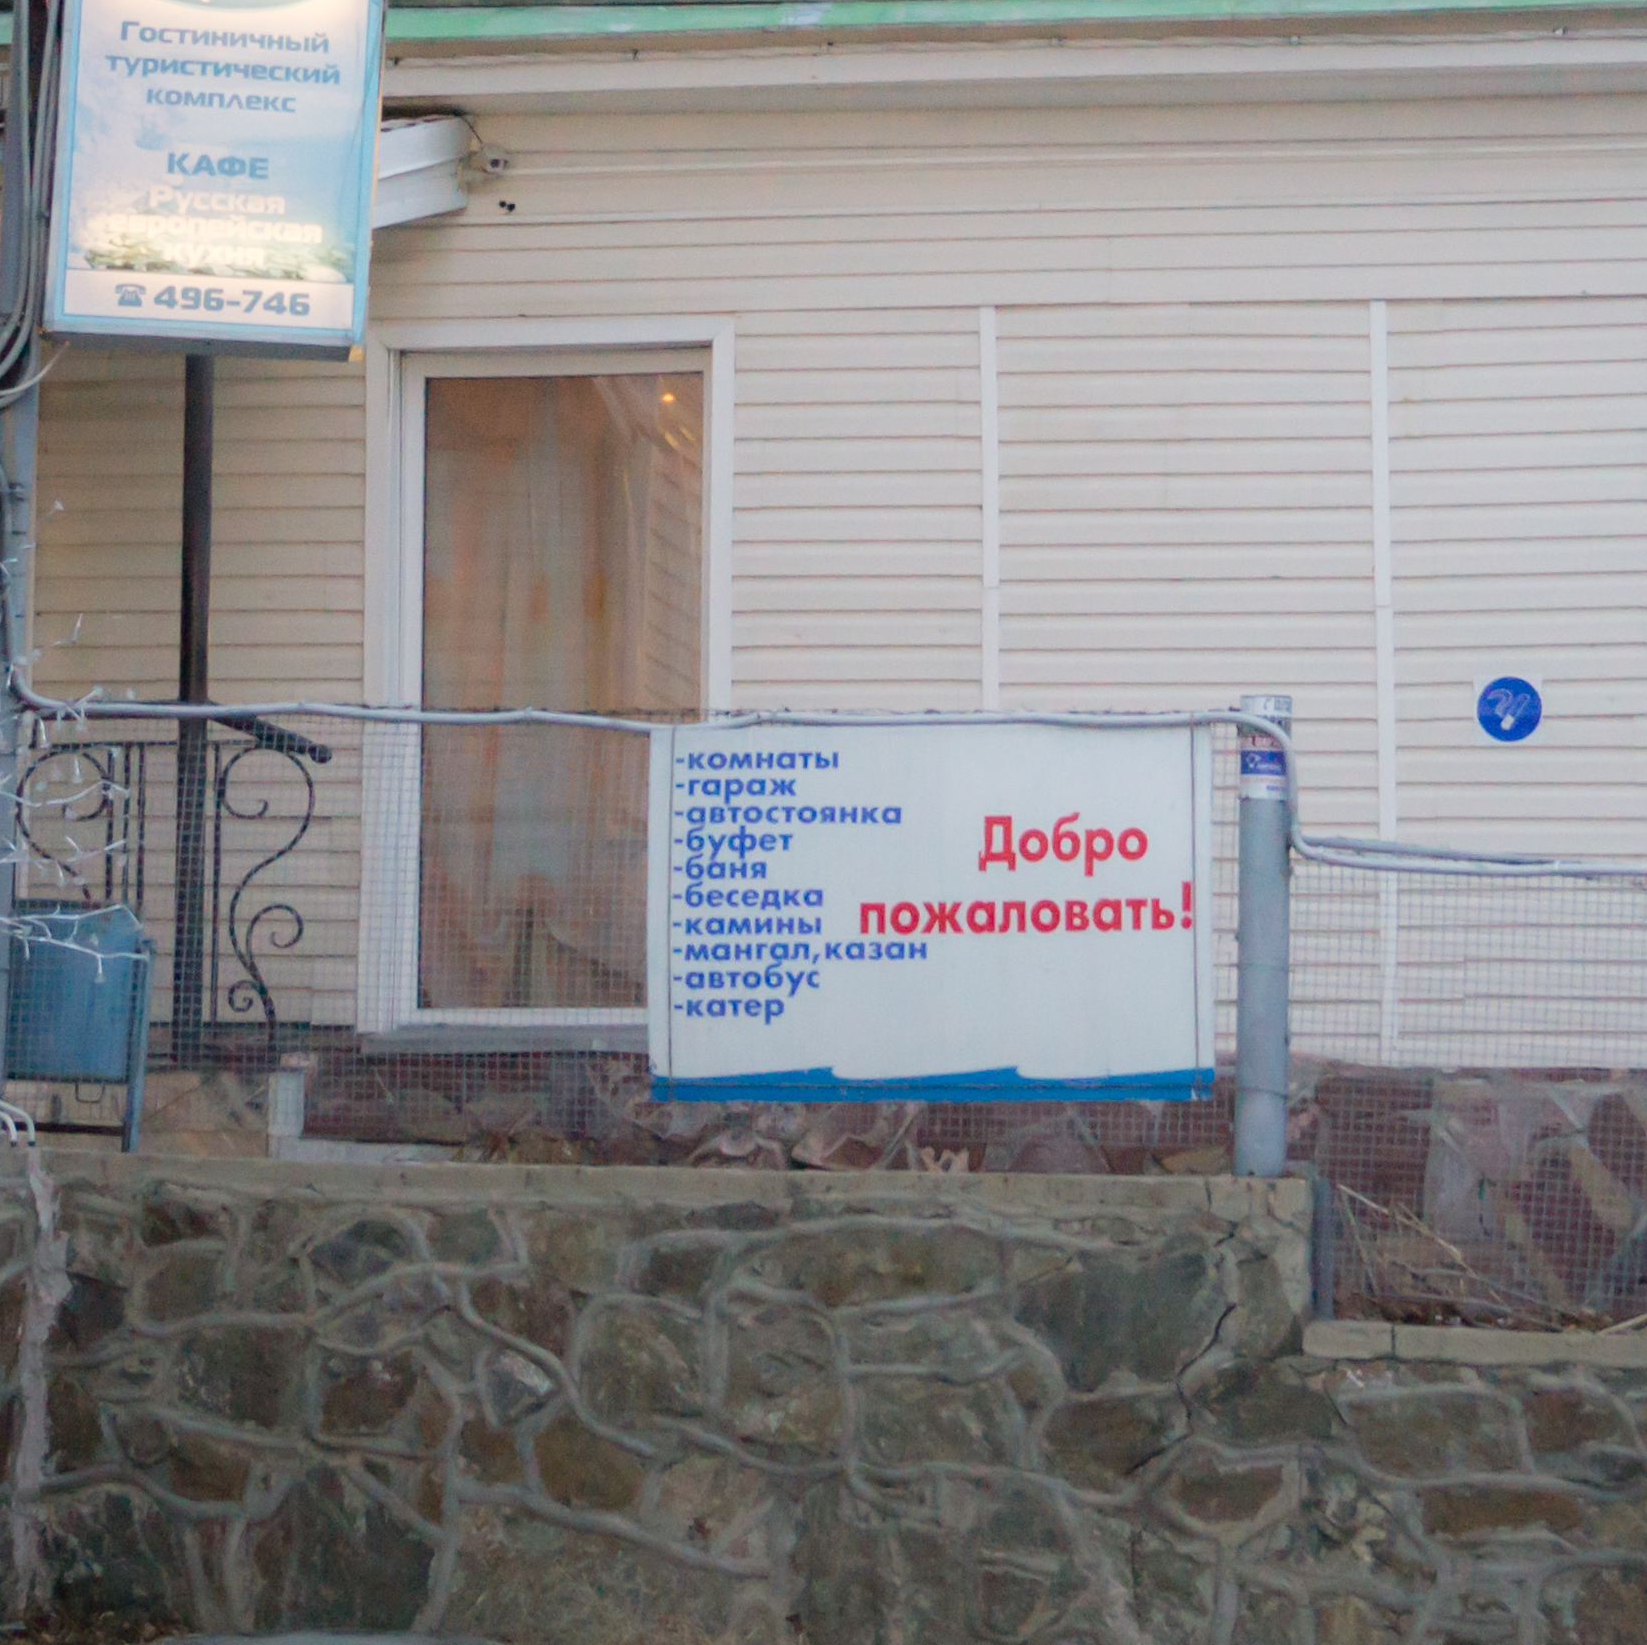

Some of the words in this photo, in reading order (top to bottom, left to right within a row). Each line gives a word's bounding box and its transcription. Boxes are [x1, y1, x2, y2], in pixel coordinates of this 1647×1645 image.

[120, 20, 330, 53] Гостиничный
[105, 54, 341, 85] туристический
[146, 88, 297, 113] комплекс
[167, 152, 269, 180] КАФЕ
[149, 184, 286, 215] Русская
[109, 213, 323, 244] европейская
[163, 241, 266, 267] кухня
[154, 285, 311, 317] 496-746
[978, 812, 1148, 877] Добро
[859, 881, 1193, 935] пожаловать!
